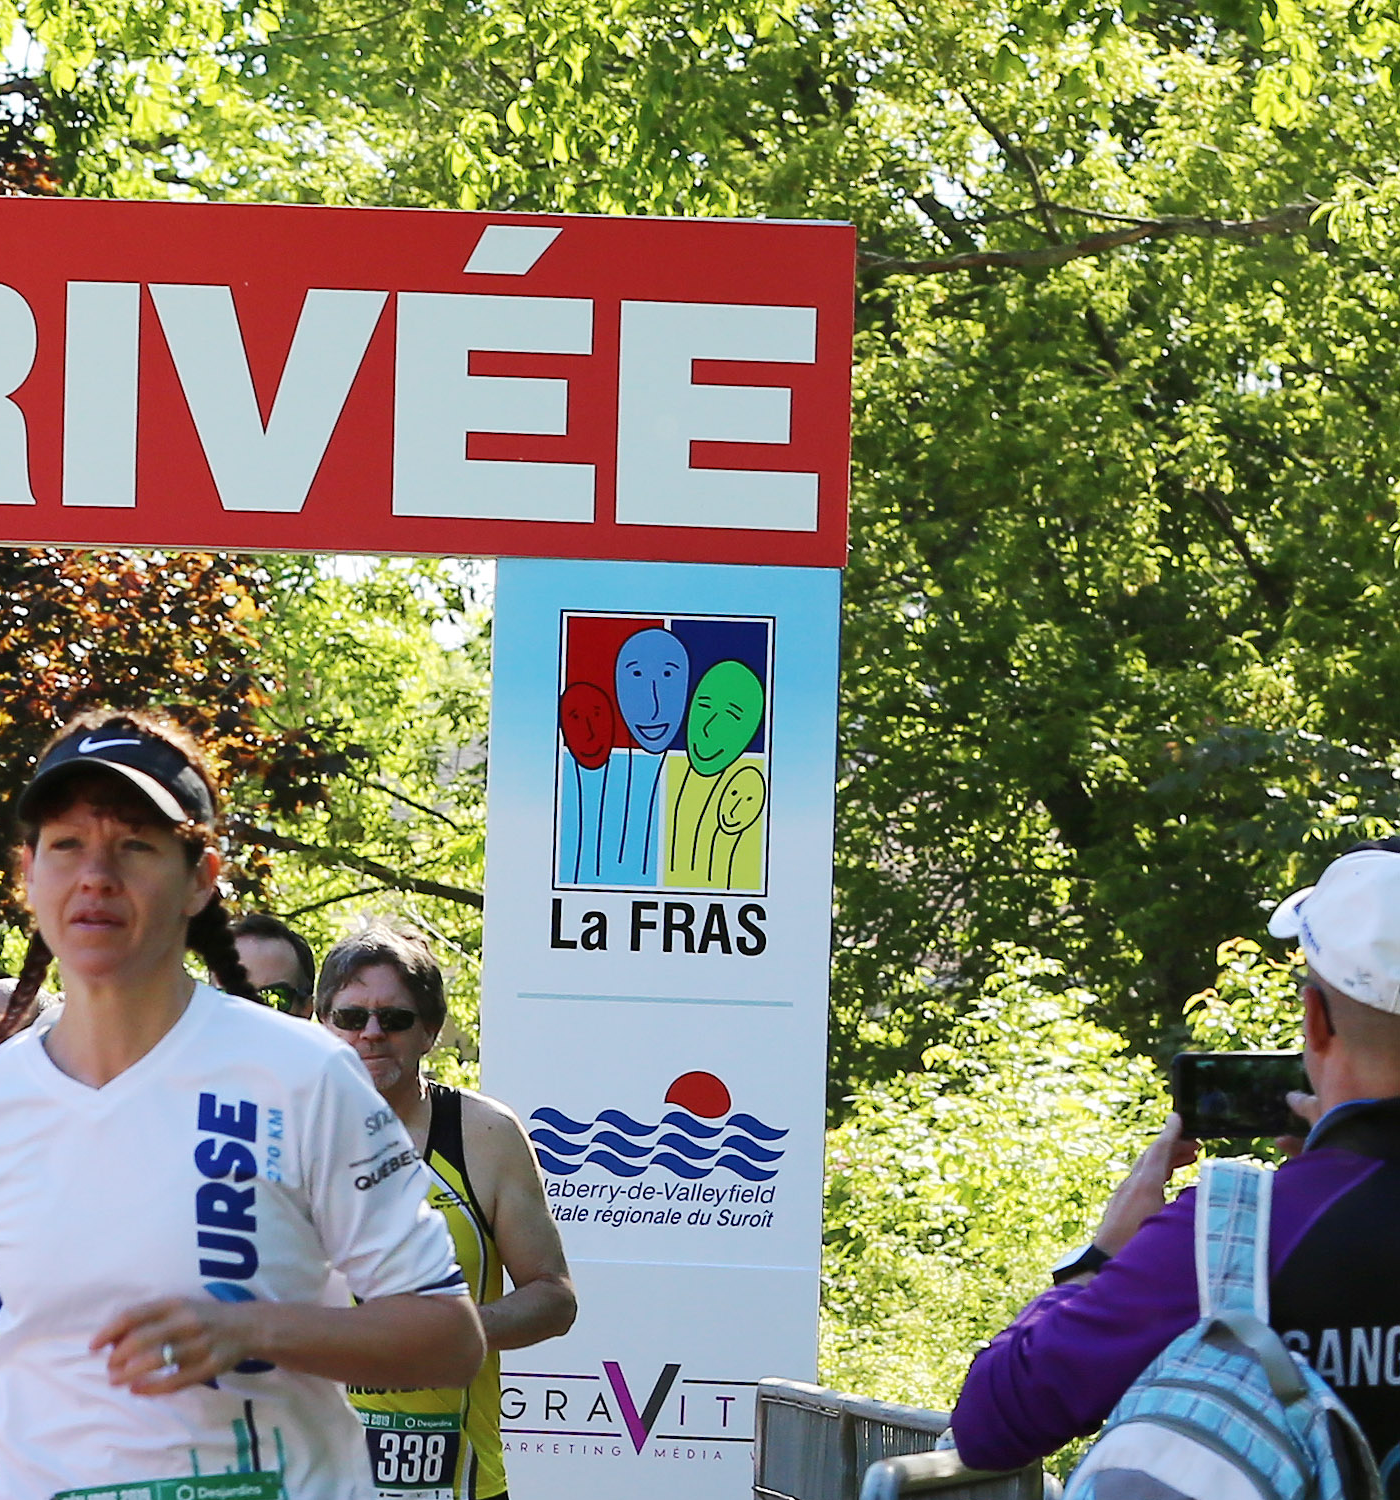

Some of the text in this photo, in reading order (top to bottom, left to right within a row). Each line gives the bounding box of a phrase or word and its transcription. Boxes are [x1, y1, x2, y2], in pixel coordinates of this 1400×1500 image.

[550, 898, 768, 957] La FRAS
[194, 1092, 259, 1282] URSE
[544, 1178, 776, 1207] laberry-de-Valleyfield
[552, 1203, 774, 1228] itale régionale du Suroît
[500, 1361, 736, 1455] GRAVIT
[377, 1432, 446, 1483] 338
[503, 1442, 722, 1461] ARKETING MÉDIA
[197, 1484, 262, 1500] Desjardins
